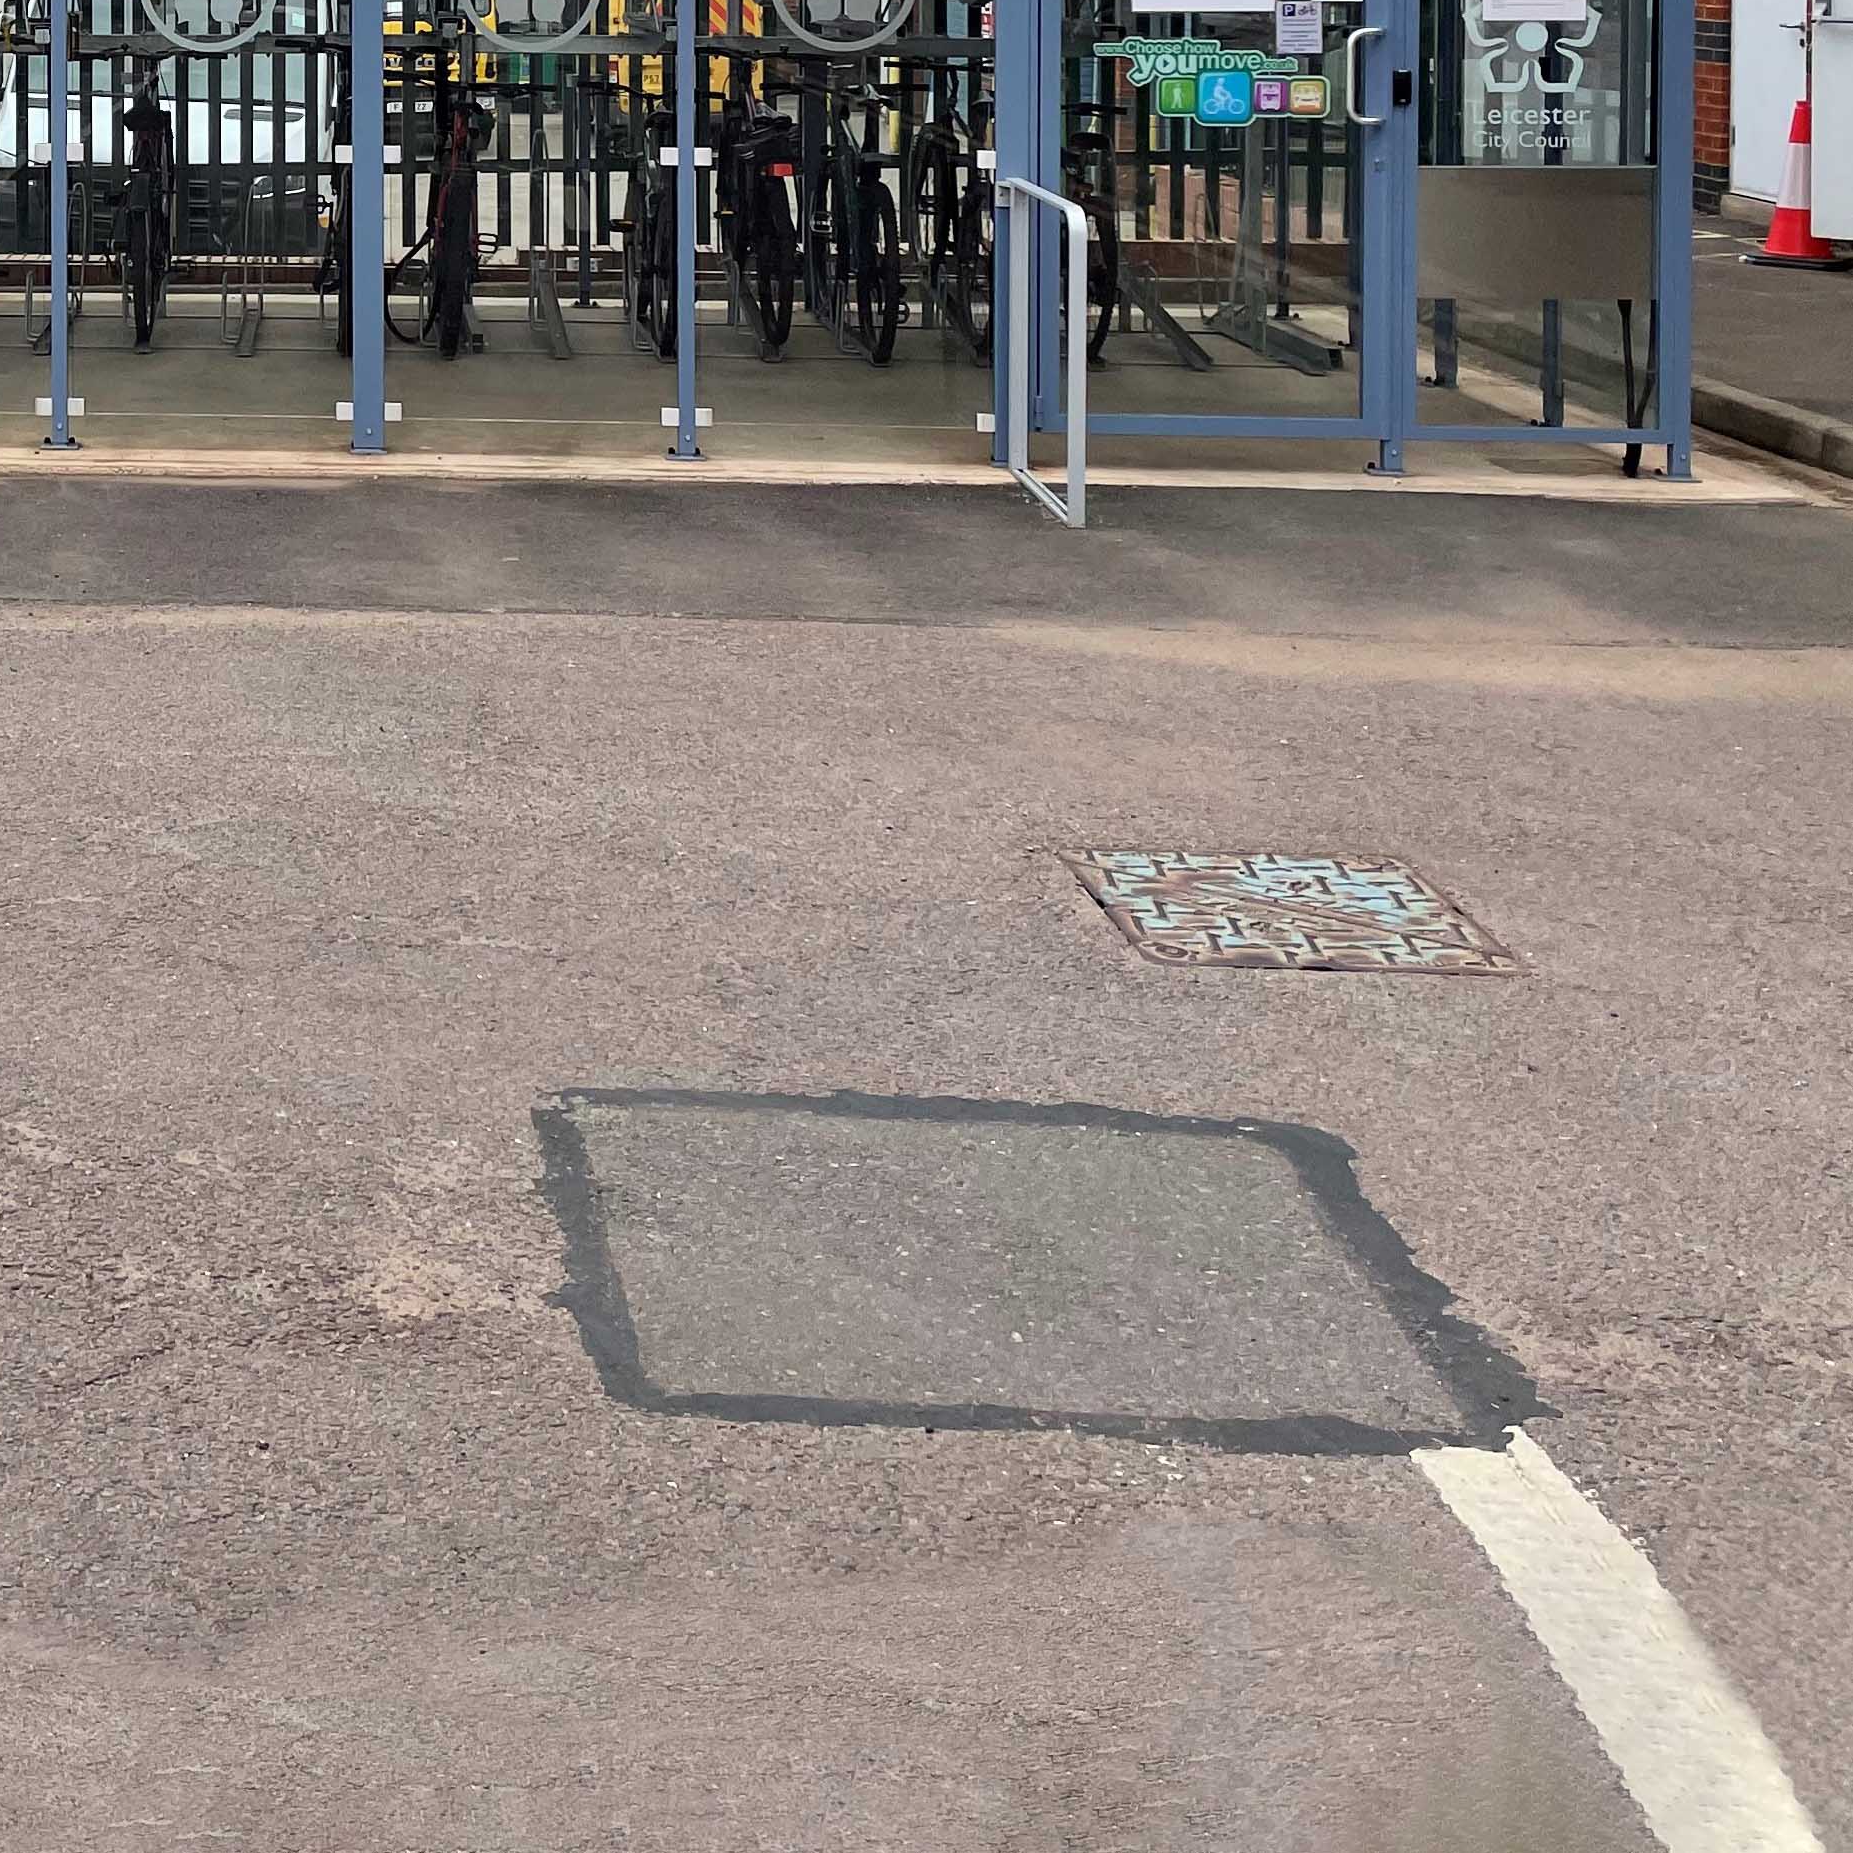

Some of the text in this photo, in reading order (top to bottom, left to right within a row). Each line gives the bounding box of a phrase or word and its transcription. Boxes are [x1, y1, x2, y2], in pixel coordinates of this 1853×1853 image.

[1284, 4, 1294, 15] P
[1473, 107, 1591, 125] Leicester
[1475, 130, 1591, 153] City Council
